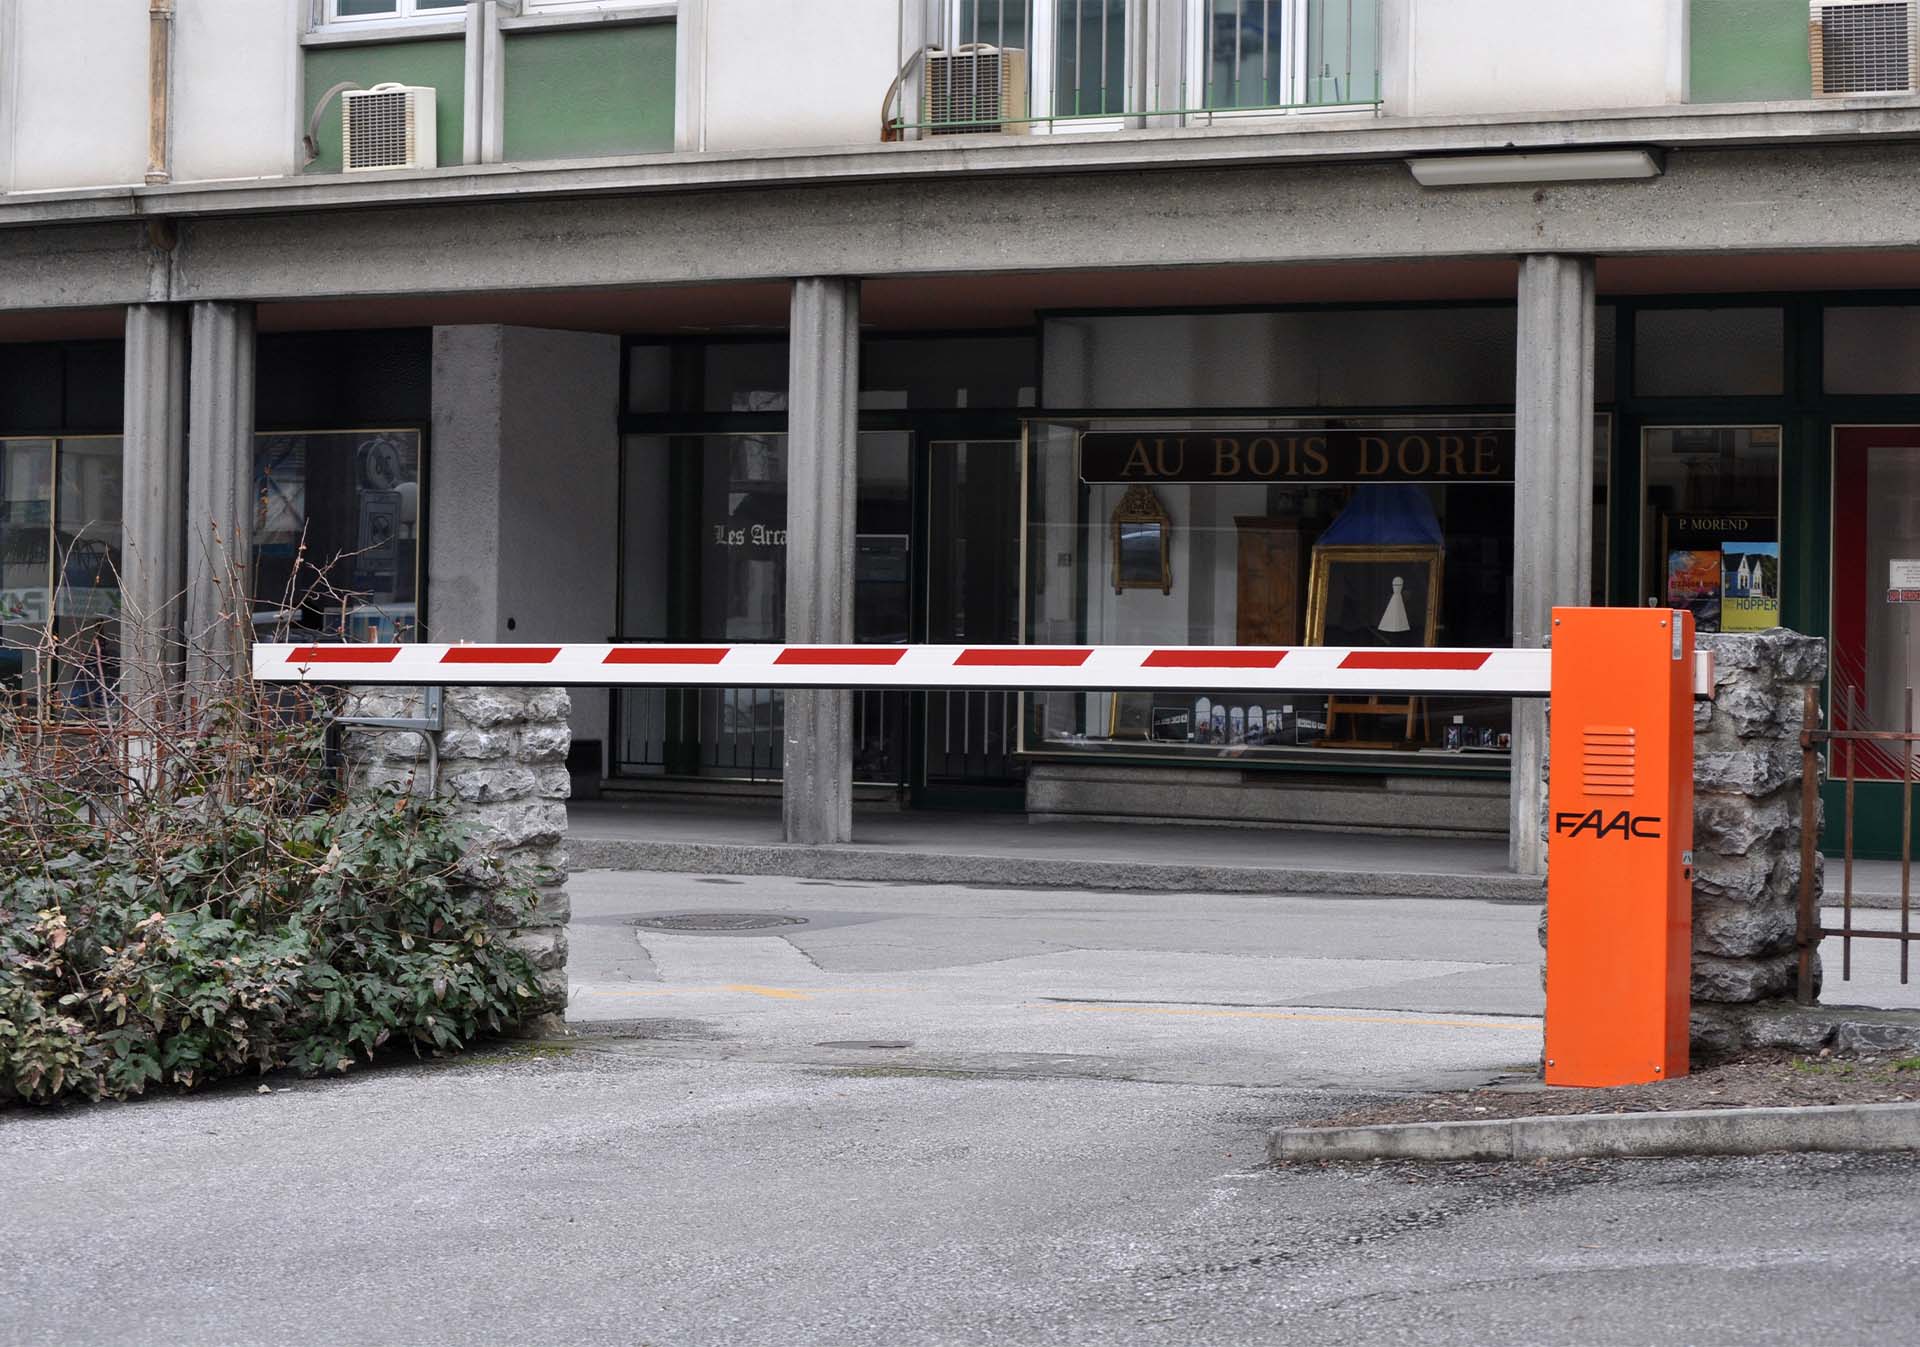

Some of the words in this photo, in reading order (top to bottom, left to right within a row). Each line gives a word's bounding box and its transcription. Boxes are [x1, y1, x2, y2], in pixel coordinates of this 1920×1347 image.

[1120, 438, 1189, 477] AU
[1210, 436, 1329, 476] BOIS
[1356, 431, 1501, 476] DORÉ
[713, 524, 746, 545] Les
[1691, 519, 1748, 530] MOREND
[1736, 599, 1778, 611] HOPPER
[1556, 809, 1661, 840] FAAC
